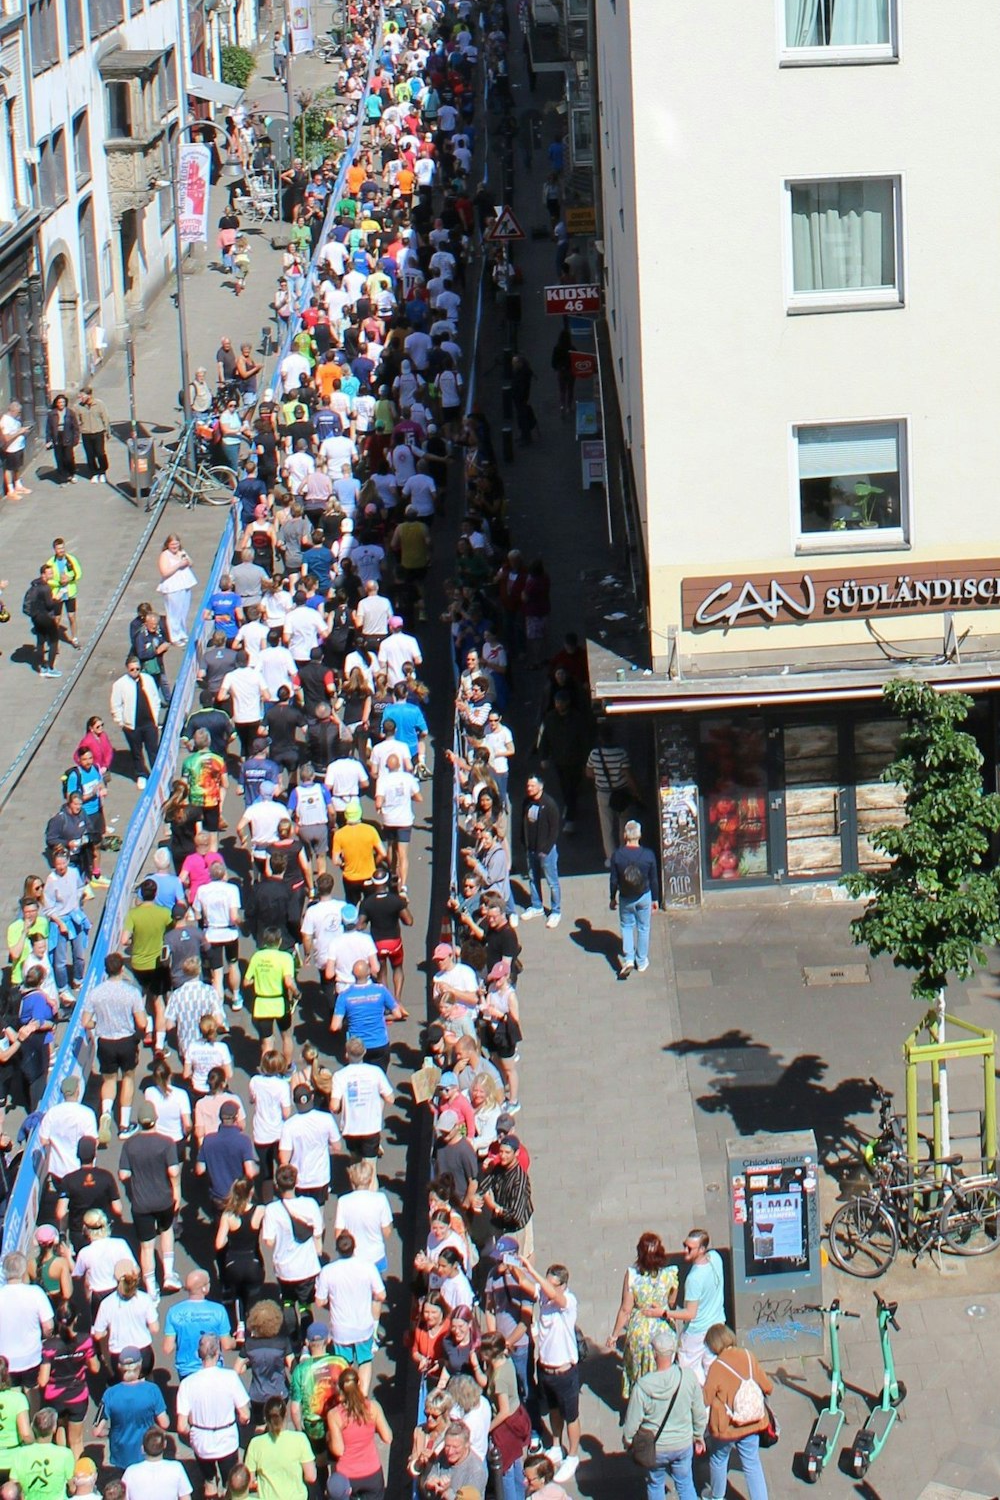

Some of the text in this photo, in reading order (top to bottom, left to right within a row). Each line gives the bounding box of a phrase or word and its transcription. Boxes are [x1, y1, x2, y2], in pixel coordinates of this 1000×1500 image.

[546, 286, 599, 301] KIOSK
[564, 300, 584, 312] 46
[695, 574, 816, 626] CAN
[742, 1155, 805, 1168] Chlodwigplatz
[768, 1198, 799, 1210] MAI
